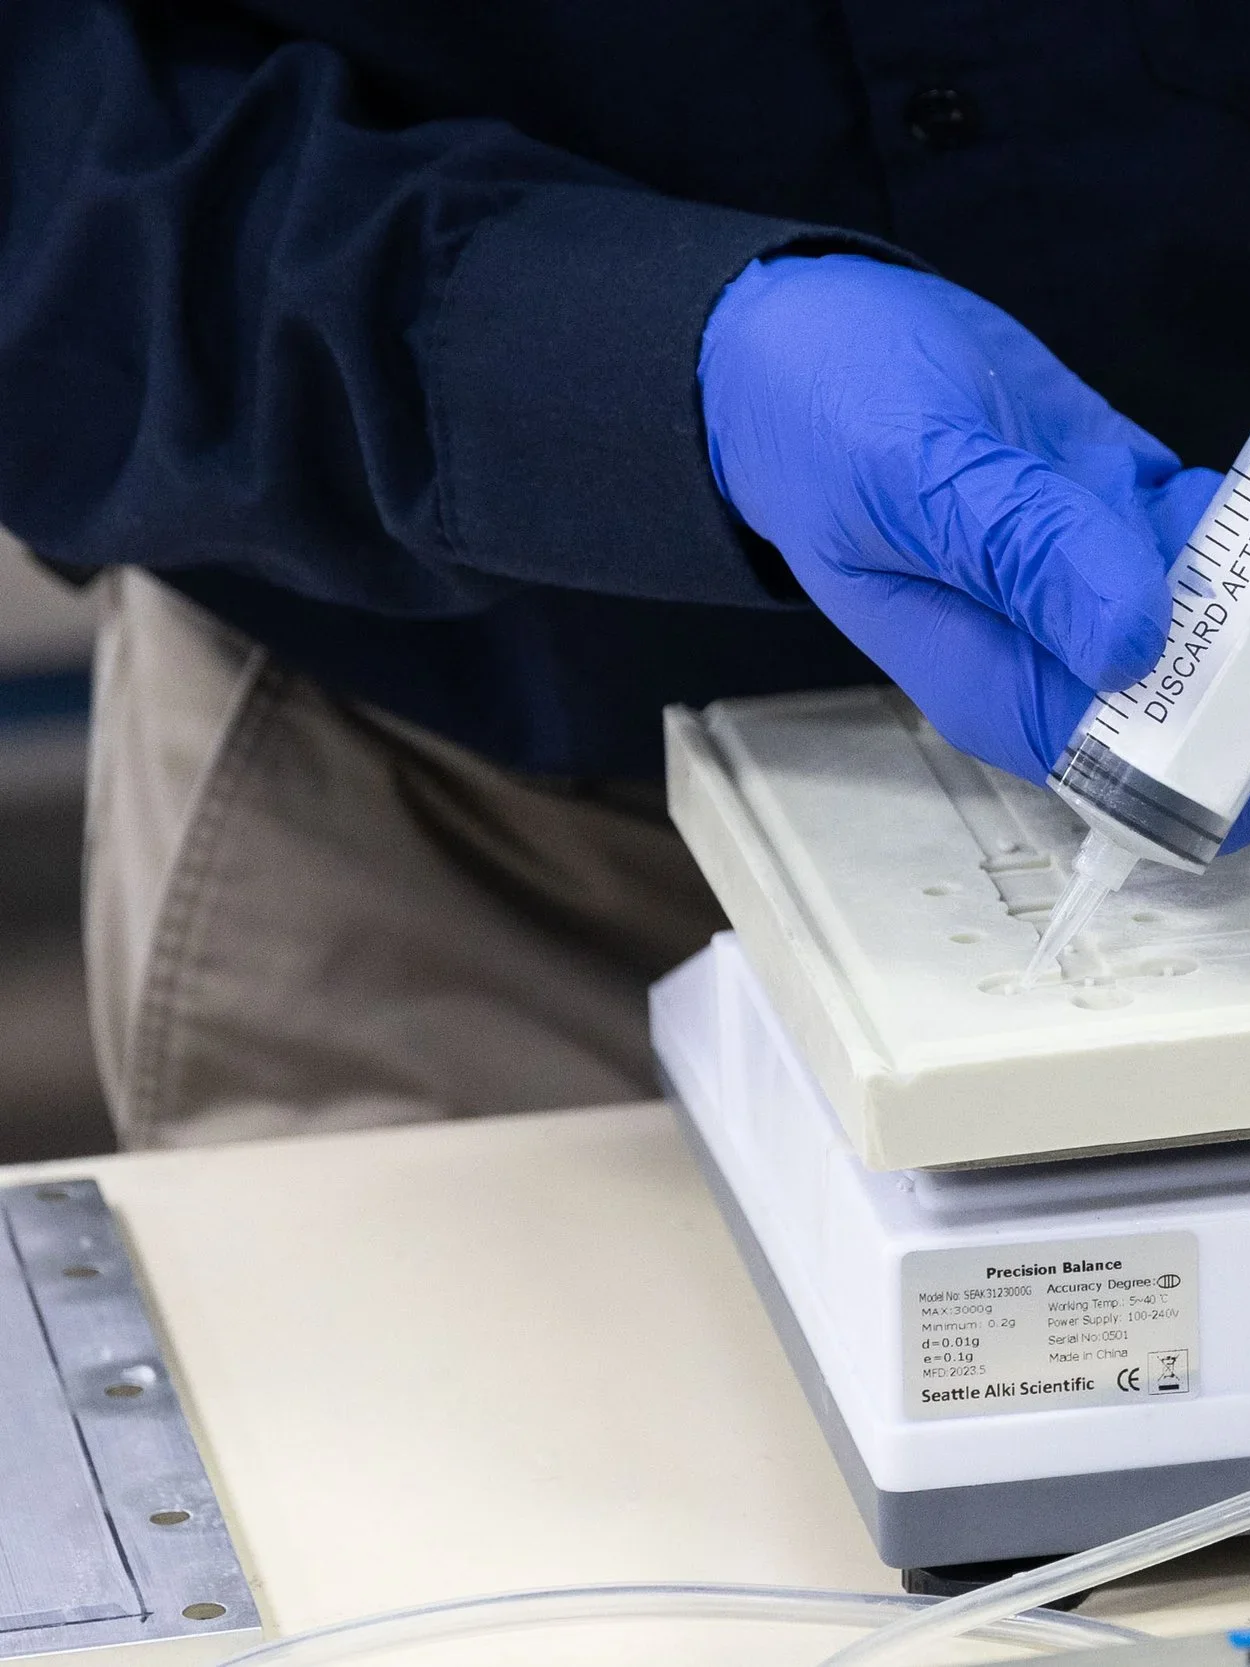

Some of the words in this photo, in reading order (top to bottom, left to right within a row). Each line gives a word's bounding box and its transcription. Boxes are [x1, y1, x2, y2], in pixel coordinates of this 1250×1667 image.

[1144, 600, 1229, 724] DISCARD
[986, 1263, 1057, 1279] Precision
[1062, 1259, 1122, 1274] Balance
[1047, 1281, 1102, 1294] Accuracy
[1107, 1277, 1156, 1290] Degree:
[919, 1291, 944, 1303] Model
[964, 1285, 1032, 1300] SEAK3123000G
[1048, 1300, 1088, 1312] Working
[921, 1321, 983, 1333] Minimum:
[987, 1318, 1016, 1329] 0.2g
[1047, 1316, 1078, 1328] Power
[1082, 1312, 1122, 1326] Supply:
[1128, 1307, 1180, 1323] 100-240V
[921, 1336, 981, 1350] d=0.01g
[1048, 1332, 1079, 1346] Serial
[923, 1352, 974, 1364] e=0.1g
[1049, 1351, 1080, 1363] Made
[1083, 1350, 1093, 1361] in
[1096, 1348, 1128, 1360] China
[921, 1386, 981, 1403] Seattle
[984, 1382, 1016, 1399] Alki
[1020, 1376, 1095, 1396] Scientific
